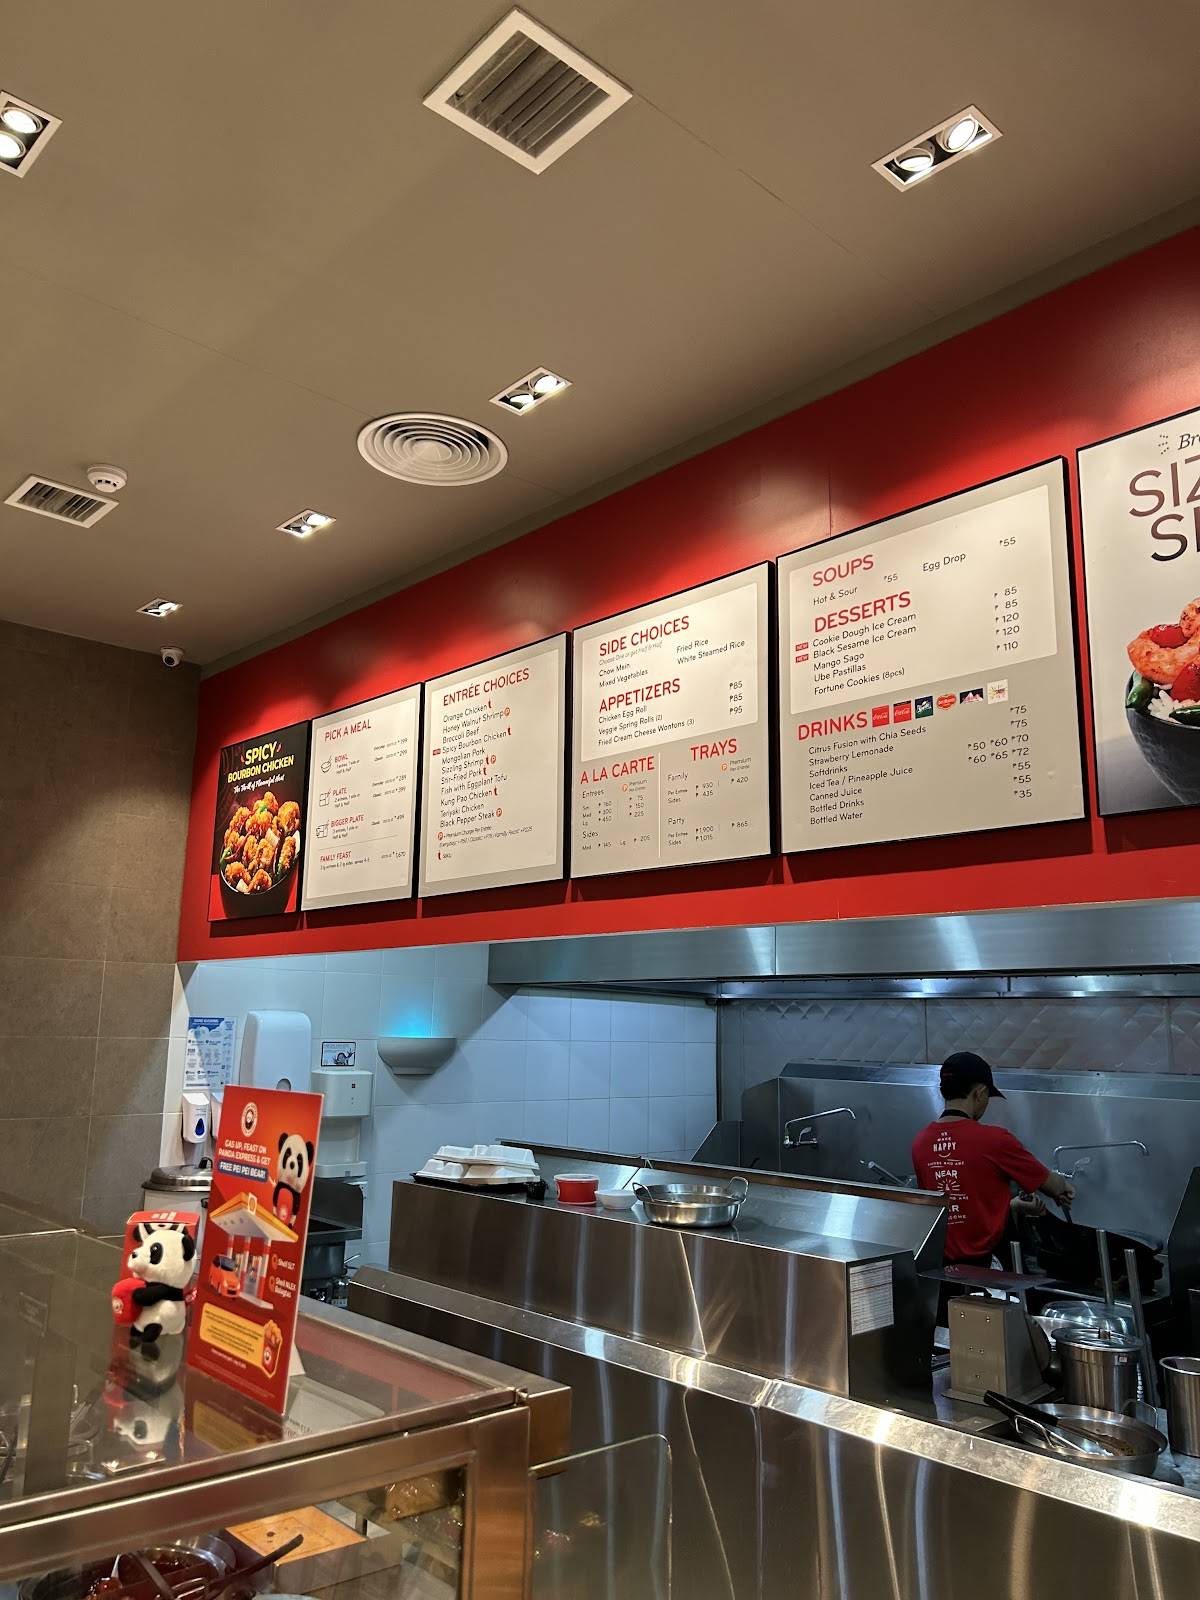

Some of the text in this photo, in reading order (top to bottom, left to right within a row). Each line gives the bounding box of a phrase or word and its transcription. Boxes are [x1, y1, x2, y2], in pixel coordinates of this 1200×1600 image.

[813, 554, 874, 587] SOUPS
[923, 553, 966, 572] Egg Drop
[813, 596, 827, 606] Hot
[839, 587, 857, 598] Sour
[815, 591, 911, 632] DESSERTS
[599, 636, 627, 656] SIDE
[631, 616, 690, 646] CHOICES
[813, 635, 840, 647] Cookie
[842, 627, 869, 638] Dough
[887, 614, 916, 627] Cream
[676, 638, 709, 653] Fried Rice
[813, 647, 834, 658] Black
[837, 640, 869, 652] Sesame
[887, 626, 916, 638] Cream
[677, 640, 745, 665] White Steamed Rice
[814, 652, 865, 671] Mango Sago
[599, 663, 630, 677] Chow Mein
[599, 669, 648, 688] Mixed Vegetables
[814, 664, 866, 682] Ube Pastillas
[443, 668, 529, 706] ENTRÉE CHOICES
[814, 667, 905, 695] Fortune Cookies (8pcs)
[600, 679, 681, 713] APPETIZERS
[443, 704, 487, 723] Orange Chicken
[443, 710, 503, 734] Honey Walnut Shrimp
[599, 705, 647, 724] Chicken Egg Roll
[325, 719, 371, 741] PICK A MEAL
[598, 736, 612, 746] Fried
[614, 732, 633, 743] Cream
[634, 727, 656, 738] Cheese
[658, 720, 685, 732] Wontons
[599, 723, 617, 735] Veggie
[619, 718, 638, 731] Spring
[639, 715, 654, 725] Rolls
[798, 712, 868, 740] DRINKS
[442, 745, 457, 754] Spicy
[459, 738, 482, 749] Bourbon
[484, 731, 506, 742] Chicken
[443, 727, 479, 744] Broccoli Beef
[809, 726, 926, 754] Citrus Fusion with Chia Seeds
[245, 741, 277, 765] SPICY
[335, 754, 348, 763] BOWL
[442, 748, 485, 764] Mongolian Pork
[691, 739, 737, 761] TRAYS
[809, 745, 894, 766] Strawberry Lemonade
[228, 755, 294, 783] BOURBON CHICKEN
[442, 759, 483, 774] Sizzling Shrimp
[469, 770, 481, 778] Pork
[580, 756, 655, 784] A LA CARTE
[809, 766, 847, 778] Softdrinks
[842, 776, 846, 785] /
[848, 771, 887, 784] Pineapple
[890, 767, 913, 776] Juice
[441, 786, 452, 794] Fish
[467, 777, 493, 789] Eggplant
[668, 772, 688, 781] Family
[333, 788, 347, 796] PLATE
[441, 797, 455, 806] Kung
[469, 790, 492, 800] Chicken
[810, 788, 862, 801] Canned Juice
[441, 803, 484, 818] Teriyaki Chicken
[810, 800, 864, 813] Bottled Drinks
[331, 818, 348, 827] BIGGER
[349, 815, 364, 823] PLATE
[440, 811, 494, 828] Black Pepper Steak
[811, 812, 863, 825] Bottled Water
[337, 851, 351, 859] FEAST
[225, 1140, 235, 1148] GAS
[244, 1143, 258, 1152] FEAST
[933, 1142, 956, 1152] HAPPY
[219, 1149, 234, 1158] PANDA
[236, 1152, 256, 1162] EXPRESS
[261, 1157, 271, 1165] GET
[220, 1161, 232, 1171] FREE
[250, 1168, 266, 1178] BEAR!
[935, 1170, 958, 1180] NEAR
